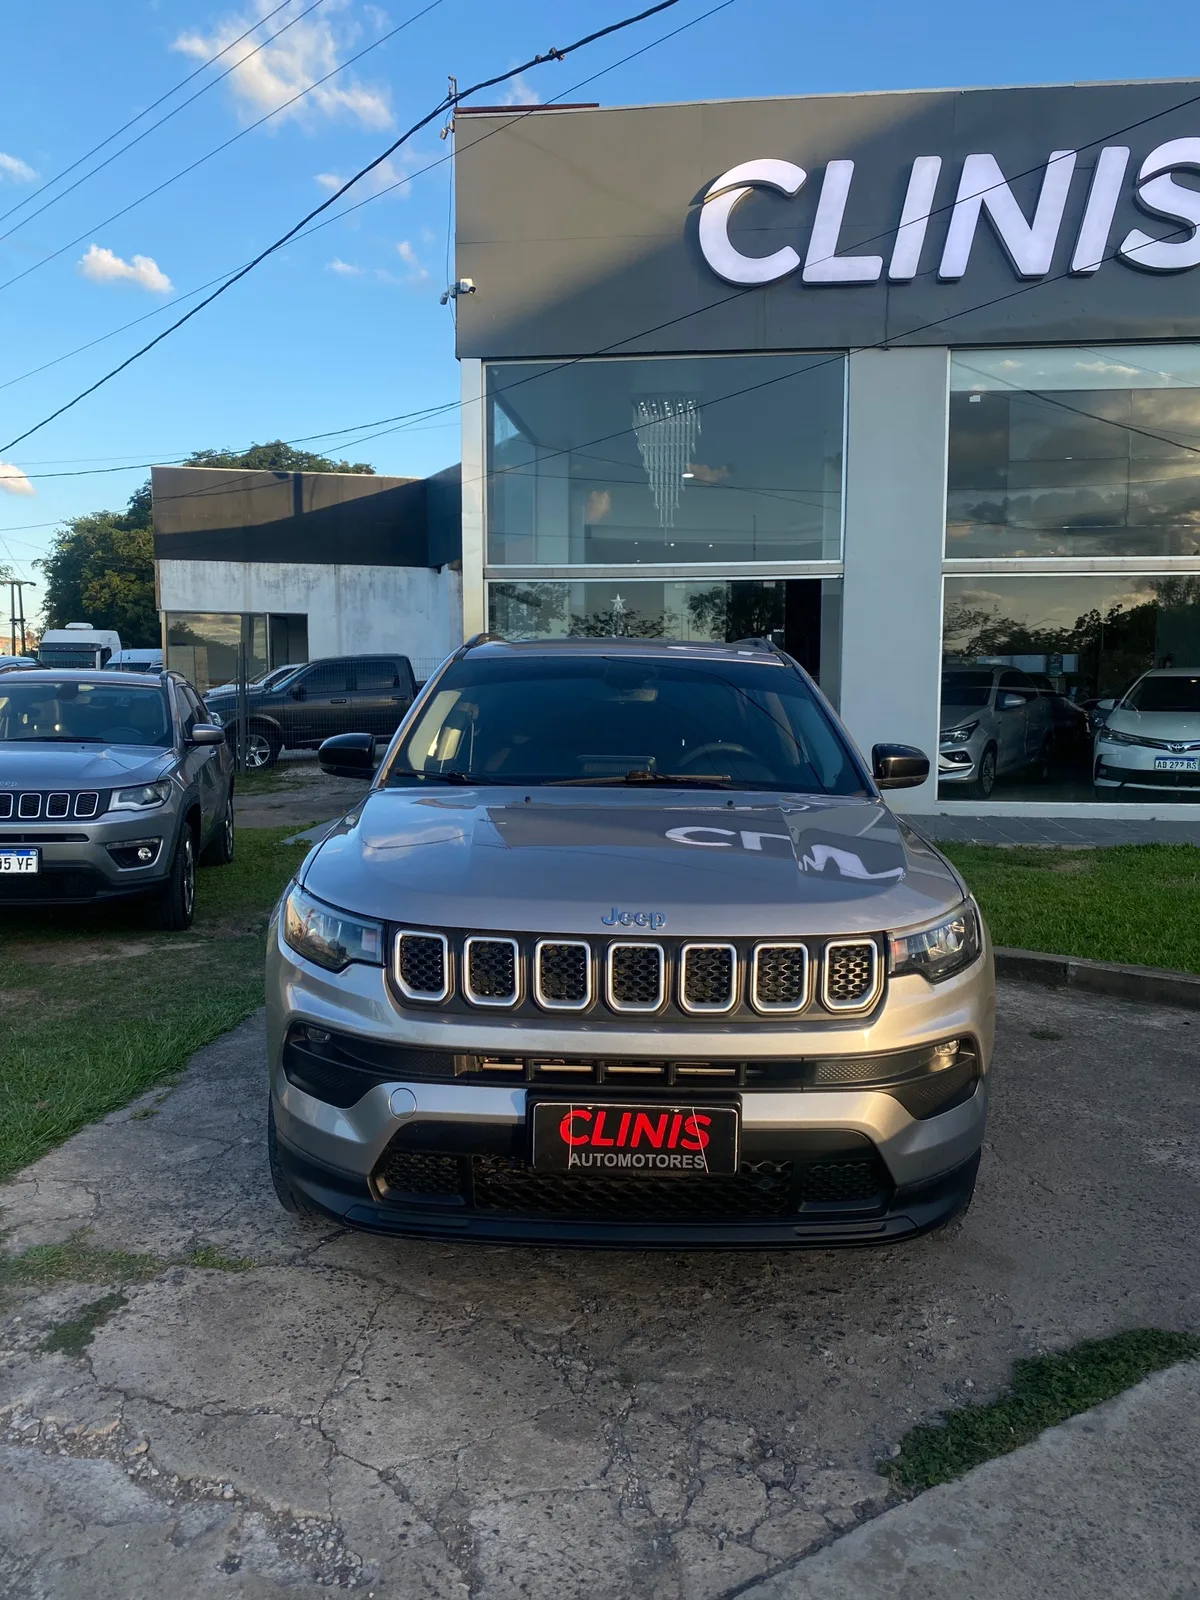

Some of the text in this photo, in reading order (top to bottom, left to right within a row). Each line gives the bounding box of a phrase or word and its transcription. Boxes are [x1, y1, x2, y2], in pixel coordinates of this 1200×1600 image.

[699, 136, 1200, 287] CLINIS
[17, 857, 33, 871] YF
[601, 906, 667, 931] Jeep
[560, 1110, 711, 1150] CLINIS
[569, 1152, 705, 1169] AUTOMOTORES
